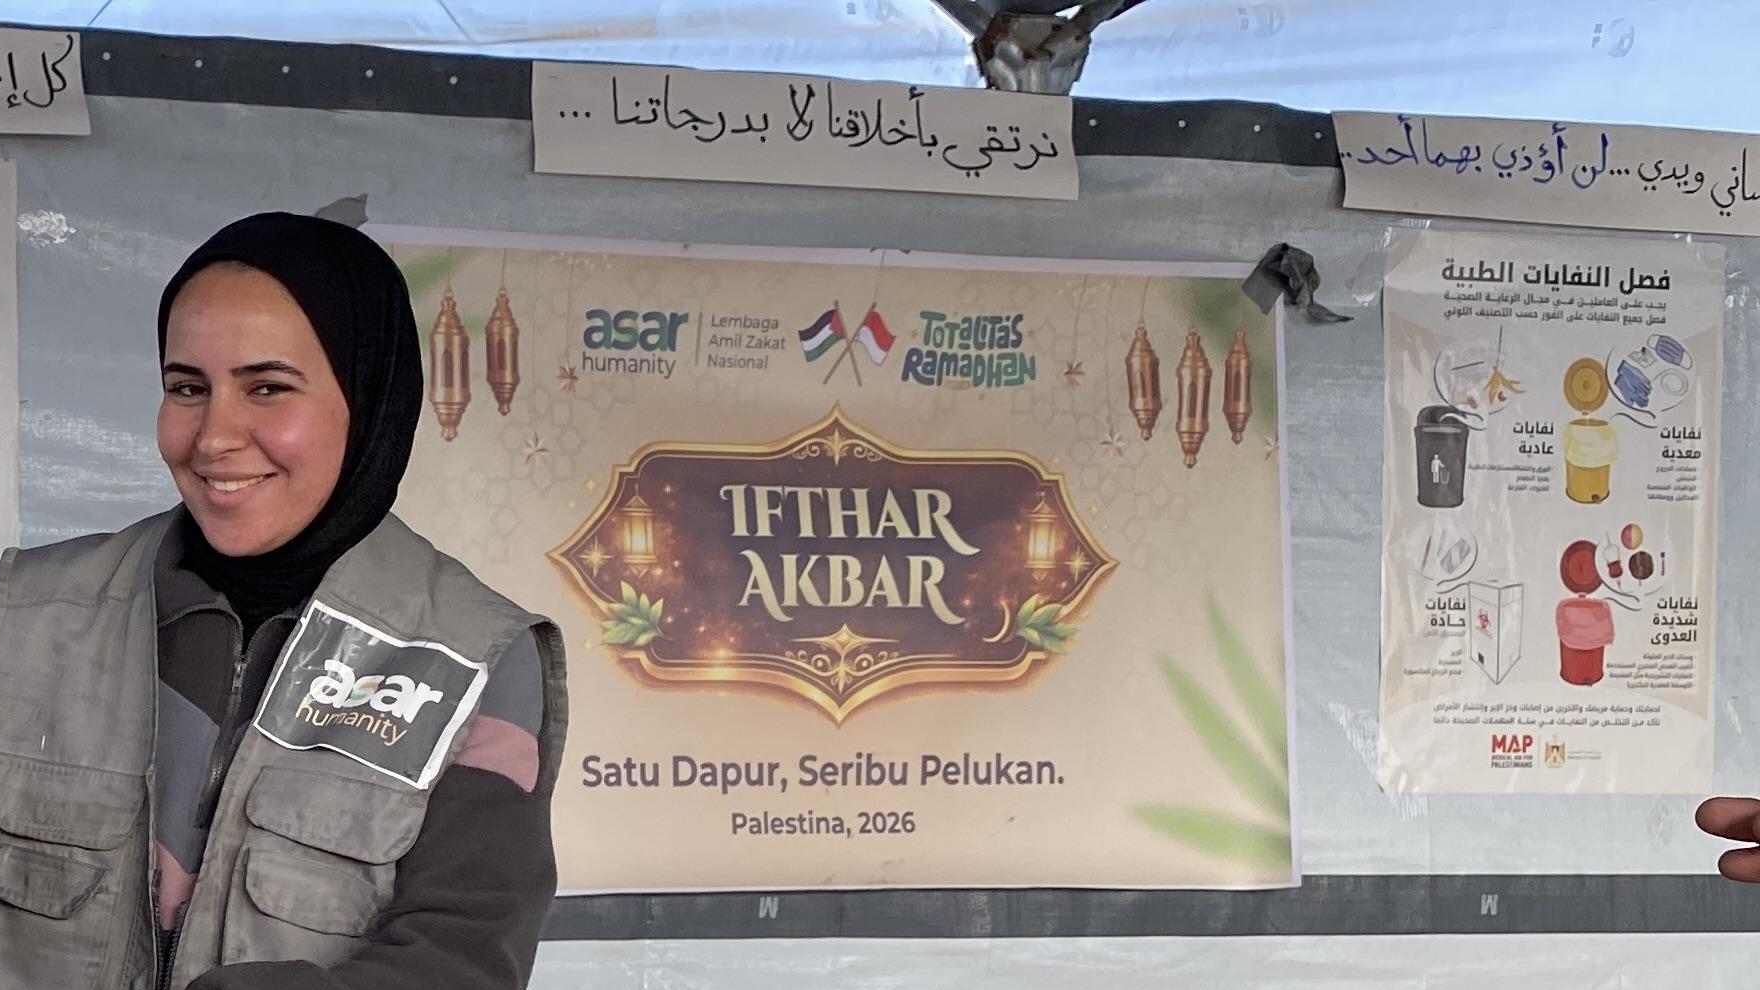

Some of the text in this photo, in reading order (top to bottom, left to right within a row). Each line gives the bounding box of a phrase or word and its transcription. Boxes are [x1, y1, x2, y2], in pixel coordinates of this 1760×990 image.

[23, 34, 73, 107] كل
[612, 74, 768, 144] بدرجاتنا
[787, 83, 815, 141] لا
[827, 80, 938, 157] بأخلاقنا
[942, 125, 1058, 178] نرتقي
[1492, 120, 1568, 184] أؤذي
[1637, 159, 1705, 194] ويدي
[1441, 258, 1670, 295] فصل النفايات الطبية
[583, 309, 689, 352] asar
[711, 314, 779, 333] Lembaga
[708, 334, 786, 350] Amil Zakat
[582, 351, 676, 380] humanity
[707, 354, 769, 369] Nasional
[1513, 420, 1555, 439] نفايات
[1660, 425, 1702, 443] نفايات
[1518, 440, 1555, 458] عادية
[1661, 445, 1702, 462] معدية
[719, 483, 981, 557] IFTHAR
[738, 548, 967, 625] AKBAR
[1425, 596, 1466, 614] نفايات
[1656, 596, 1698, 614] نفايات
[1430, 613, 1466, 627] حادة
[1652, 611, 1698, 630] شديدة
[1650, 629, 1697, 646] العدوى
[308, 658, 444, 725] asar
[294, 694, 408, 747] humanity
[1491, 734, 1533, 753] MAP
[581, 753, 1065, 795] Satu Dapur, Seribu Pelukan.
[731, 811, 916, 838] Palestina, 2026
